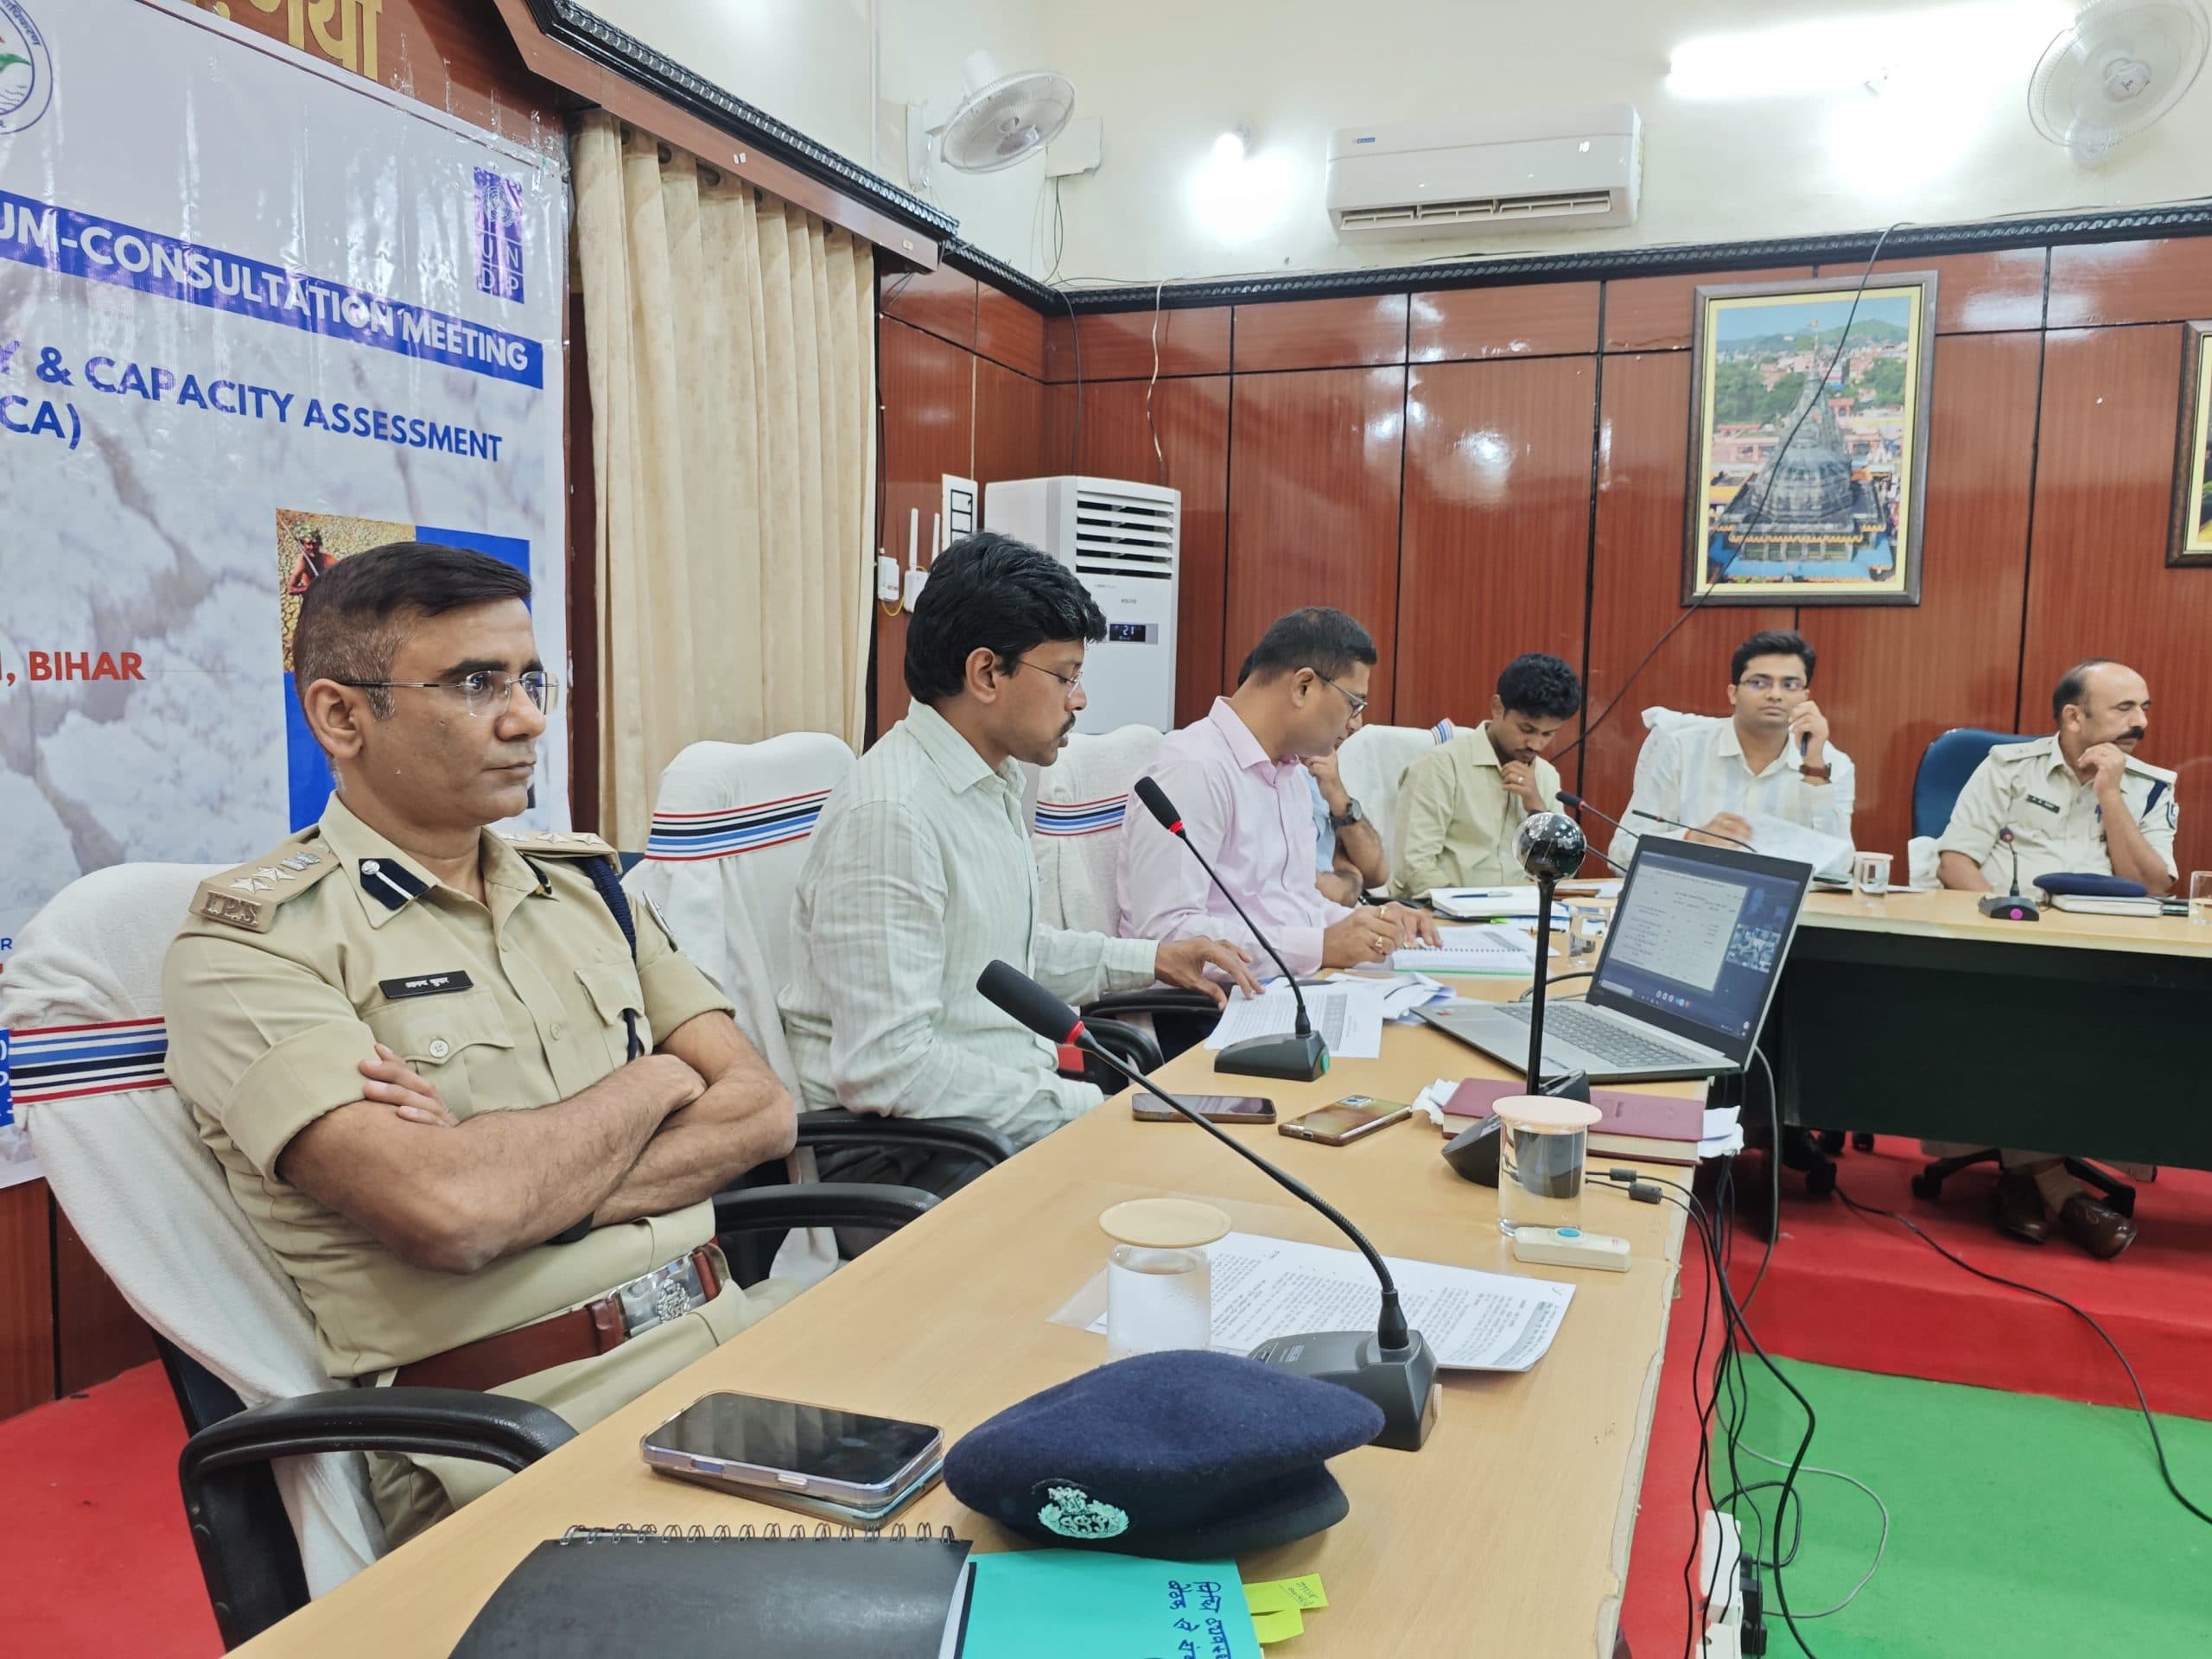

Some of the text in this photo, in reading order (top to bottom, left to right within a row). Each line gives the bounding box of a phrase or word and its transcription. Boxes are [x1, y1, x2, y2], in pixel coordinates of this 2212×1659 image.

[402, 311, 528, 371] MEETING
[36, 346, 75, 387] &
[85, 356, 295, 423] CAPACITY
[303, 398, 503, 462] ASSESSMENT
[29, 652, 146, 681] BIHAR
